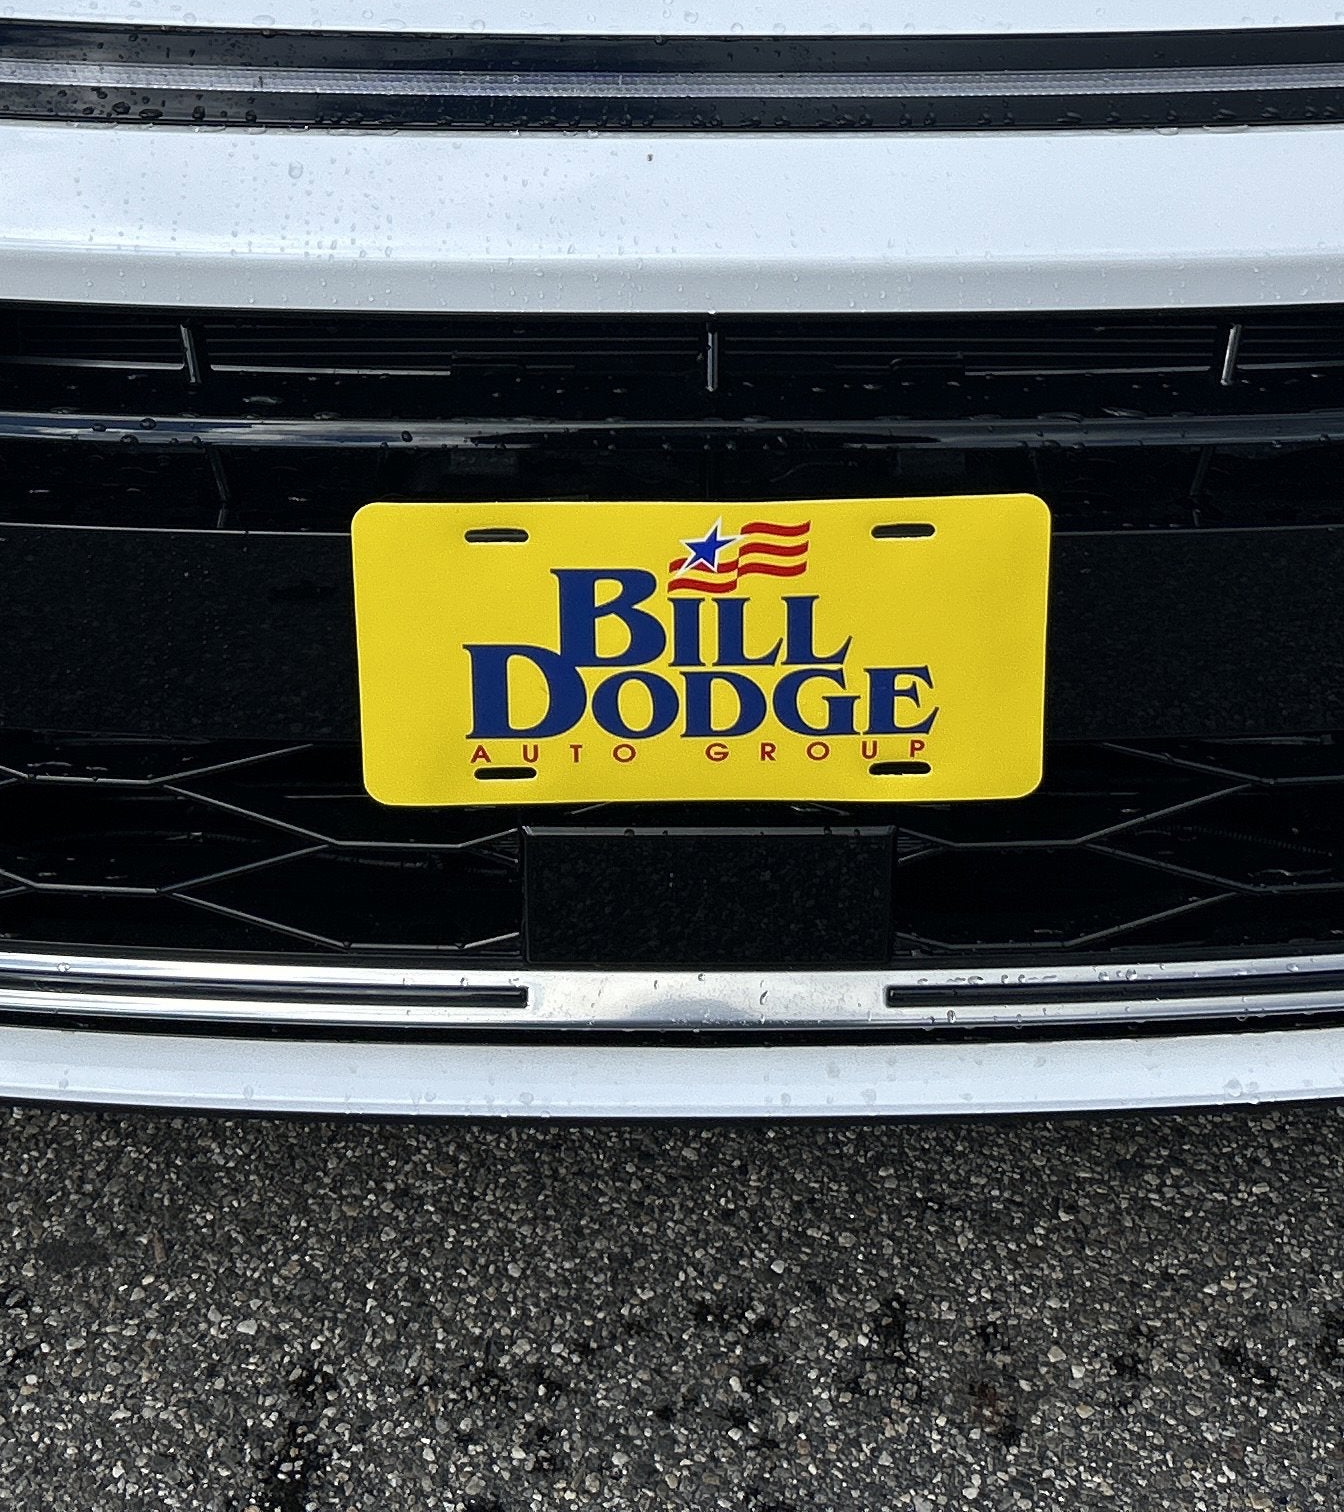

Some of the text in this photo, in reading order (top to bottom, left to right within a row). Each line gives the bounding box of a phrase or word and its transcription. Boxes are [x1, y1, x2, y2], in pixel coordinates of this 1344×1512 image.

[550, 567, 852, 668] BILL
[462, 643, 939, 739] DODGE
[470, 739, 926, 765] AUTO GROUP
